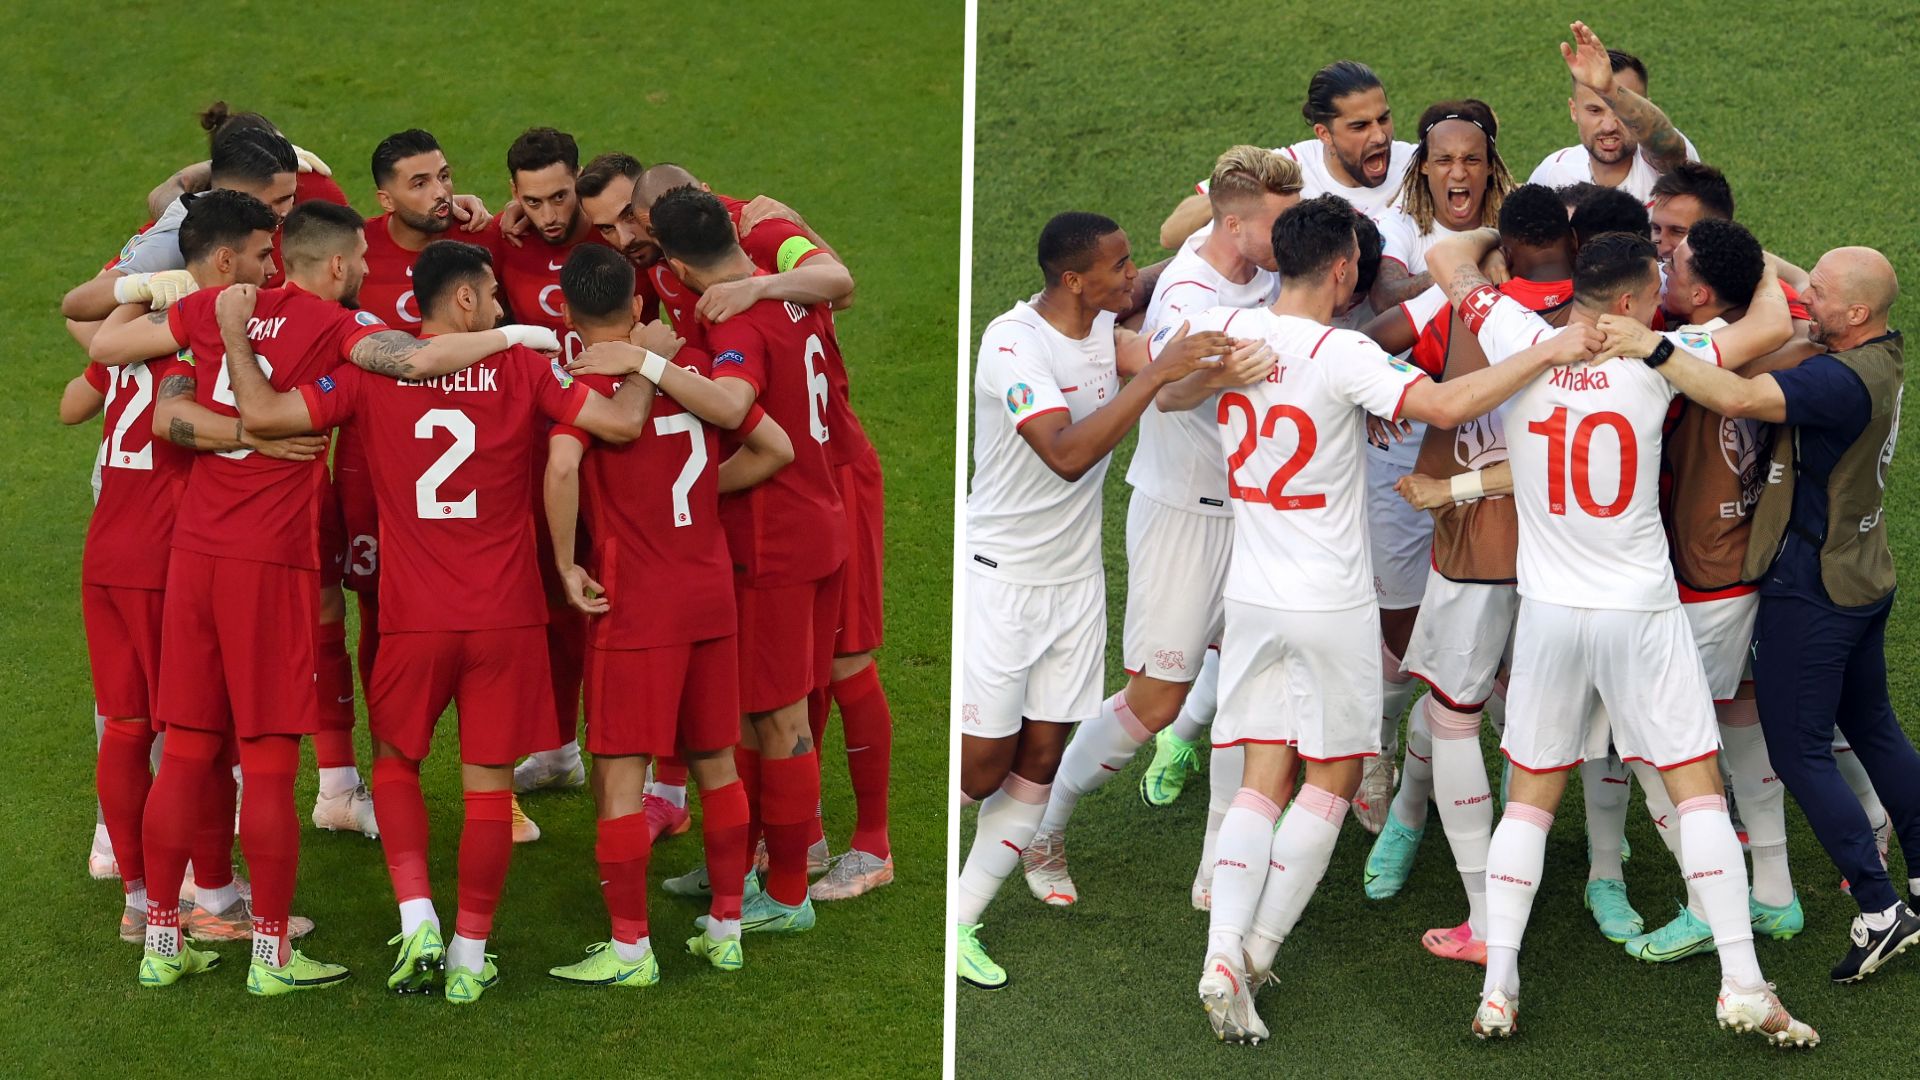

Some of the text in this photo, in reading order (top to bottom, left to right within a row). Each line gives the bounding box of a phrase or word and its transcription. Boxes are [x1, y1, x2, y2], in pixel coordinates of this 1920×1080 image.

[246, 317, 287, 341] OKAY
[1549, 366, 1610, 392] xhaka
[804, 333, 830, 446] 6
[414, 408, 477, 519] 2
[653, 411, 709, 528] 7
[1217, 391, 1327, 511] 22
[1528, 406, 1638, 518] 10
[344, 534, 378, 576] 13
[1490, 873, 1533, 888] suisse
